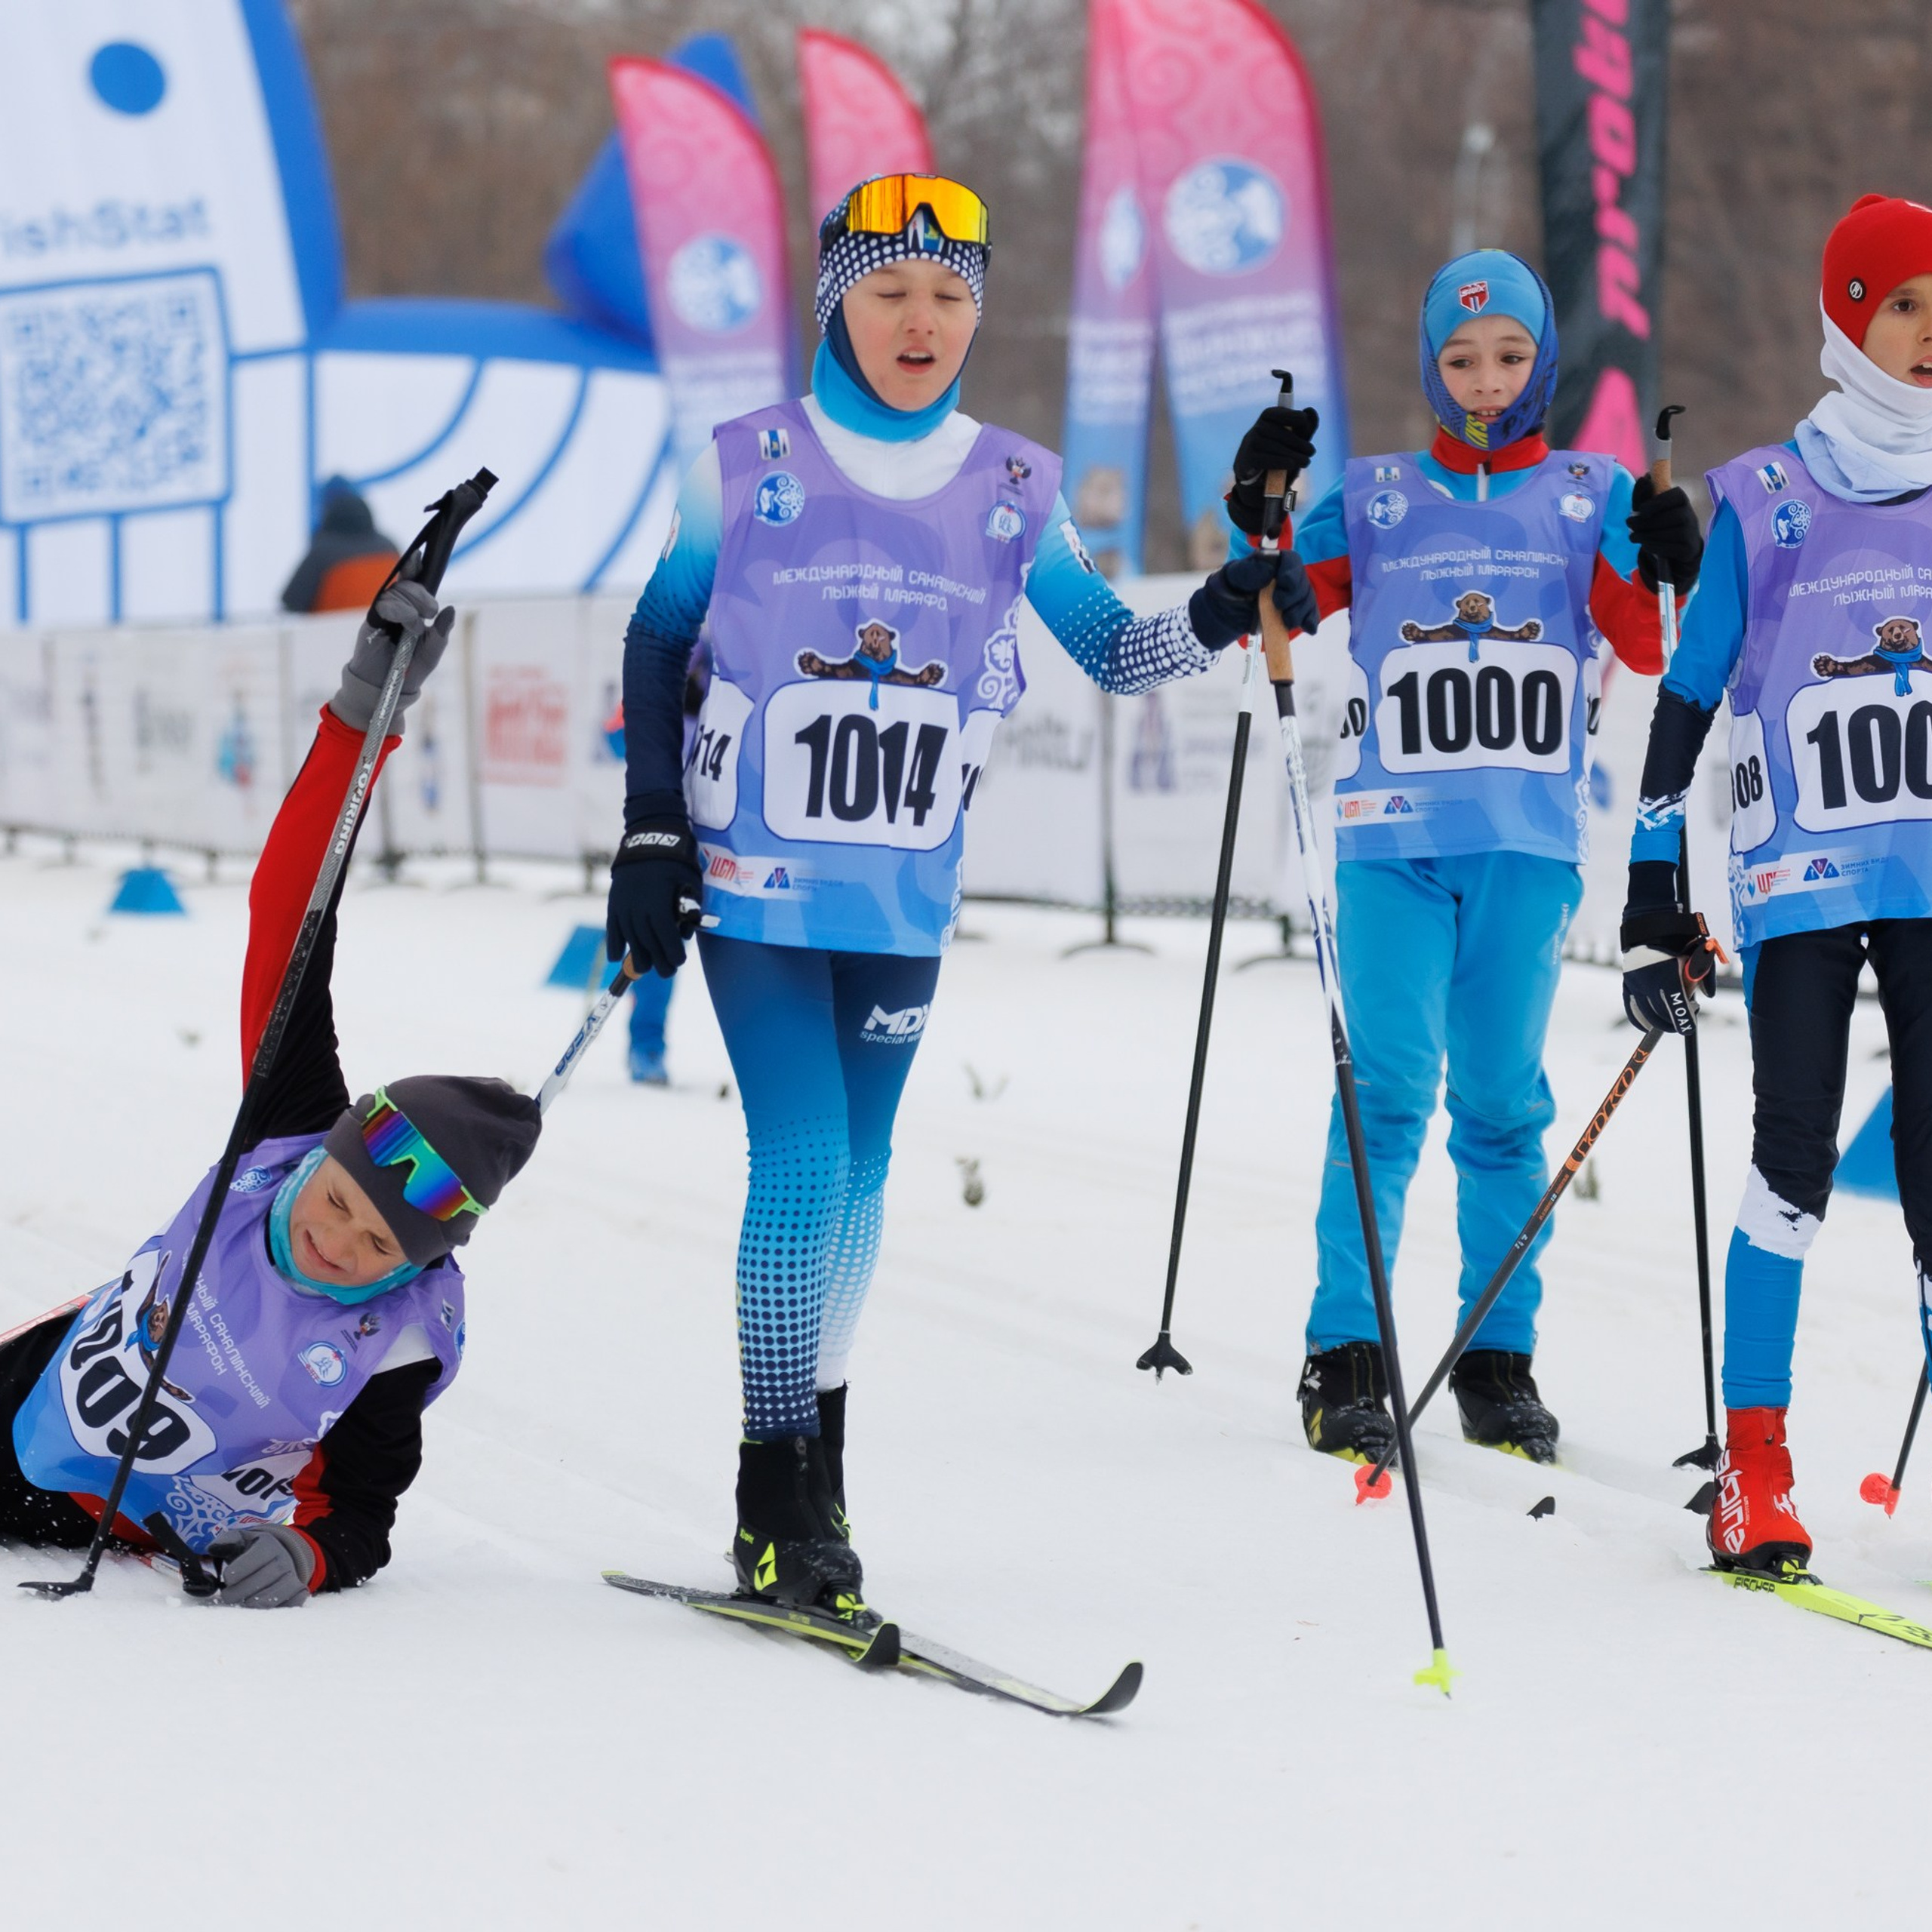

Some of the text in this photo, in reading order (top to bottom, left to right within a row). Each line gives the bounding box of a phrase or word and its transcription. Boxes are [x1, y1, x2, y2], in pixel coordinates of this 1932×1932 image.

[1477, 565, 1540, 579] МАРАФОН
[884, 587, 949, 611] МАРАФО
[1833, 584, 1895, 607] ЛЫЖНЫЙ
[1387, 666, 1563, 756] 1000
[795, 714, 948, 826] 1014
[334, 760, 373, 855] TOURING
[1841, 860, 1869, 870] ЗИМНИХ
[1841, 867, 1869, 876] СПОРТА
[1670, 992, 1693, 1033] MOAX
[860, 1030, 907, 1044] special
[186, 1302, 228, 1376] МАРАФОН
[210, 1313, 271, 1410] САХАЛИНСКИЙ
[1715, 1449, 1746, 1555] alpina
